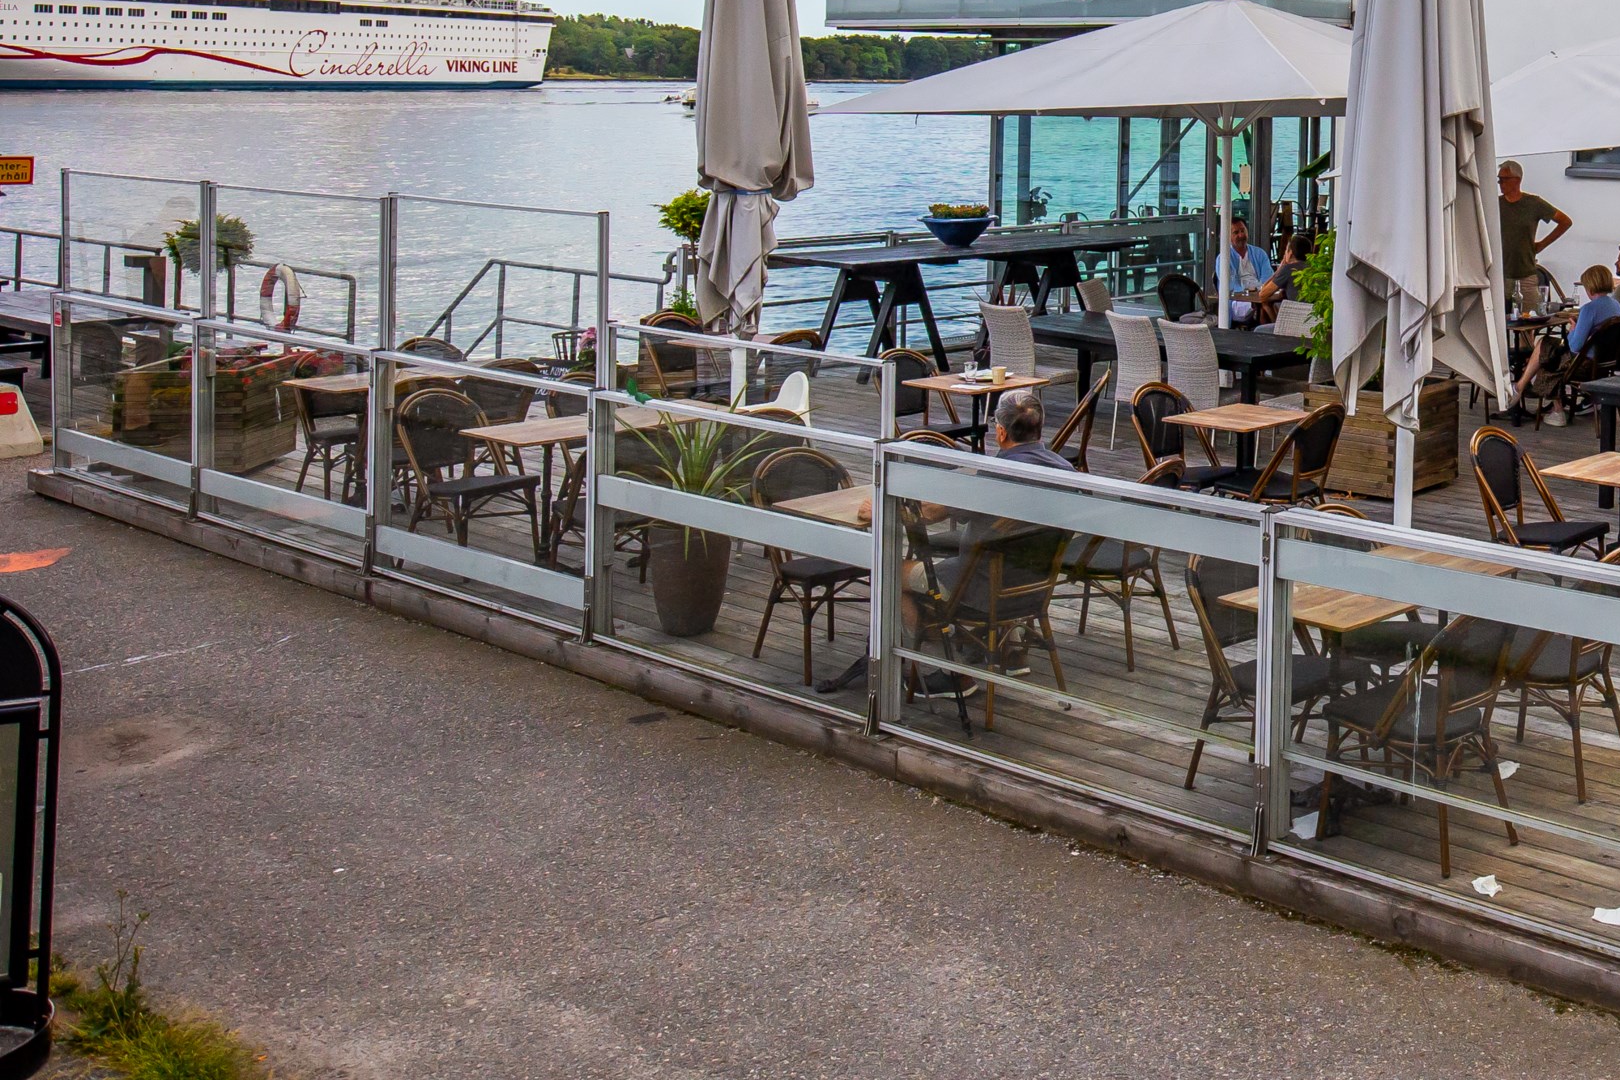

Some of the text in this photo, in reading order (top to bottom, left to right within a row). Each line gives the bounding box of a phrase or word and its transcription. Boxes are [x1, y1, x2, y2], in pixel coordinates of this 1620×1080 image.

[288, 29, 438, 78] Cinderella
[446, 59, 490, 73] VIKING
[492, 60, 518, 73] LINE
